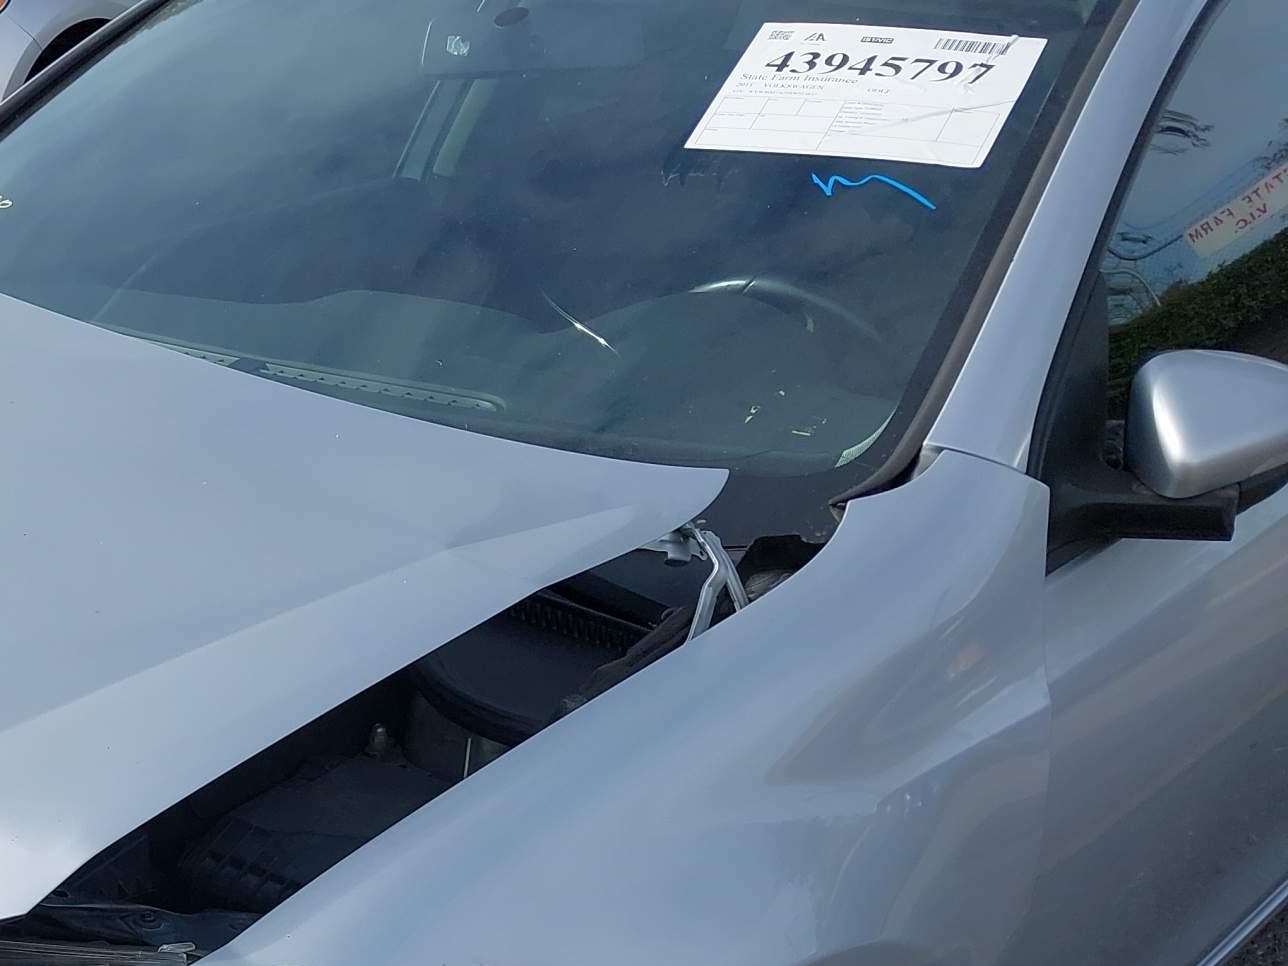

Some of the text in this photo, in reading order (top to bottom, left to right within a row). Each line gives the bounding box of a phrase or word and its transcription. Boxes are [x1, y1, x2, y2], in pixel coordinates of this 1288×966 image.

[740, 73, 860, 84] State Farm Insurance
[765, 50, 996, 87] 43945797
